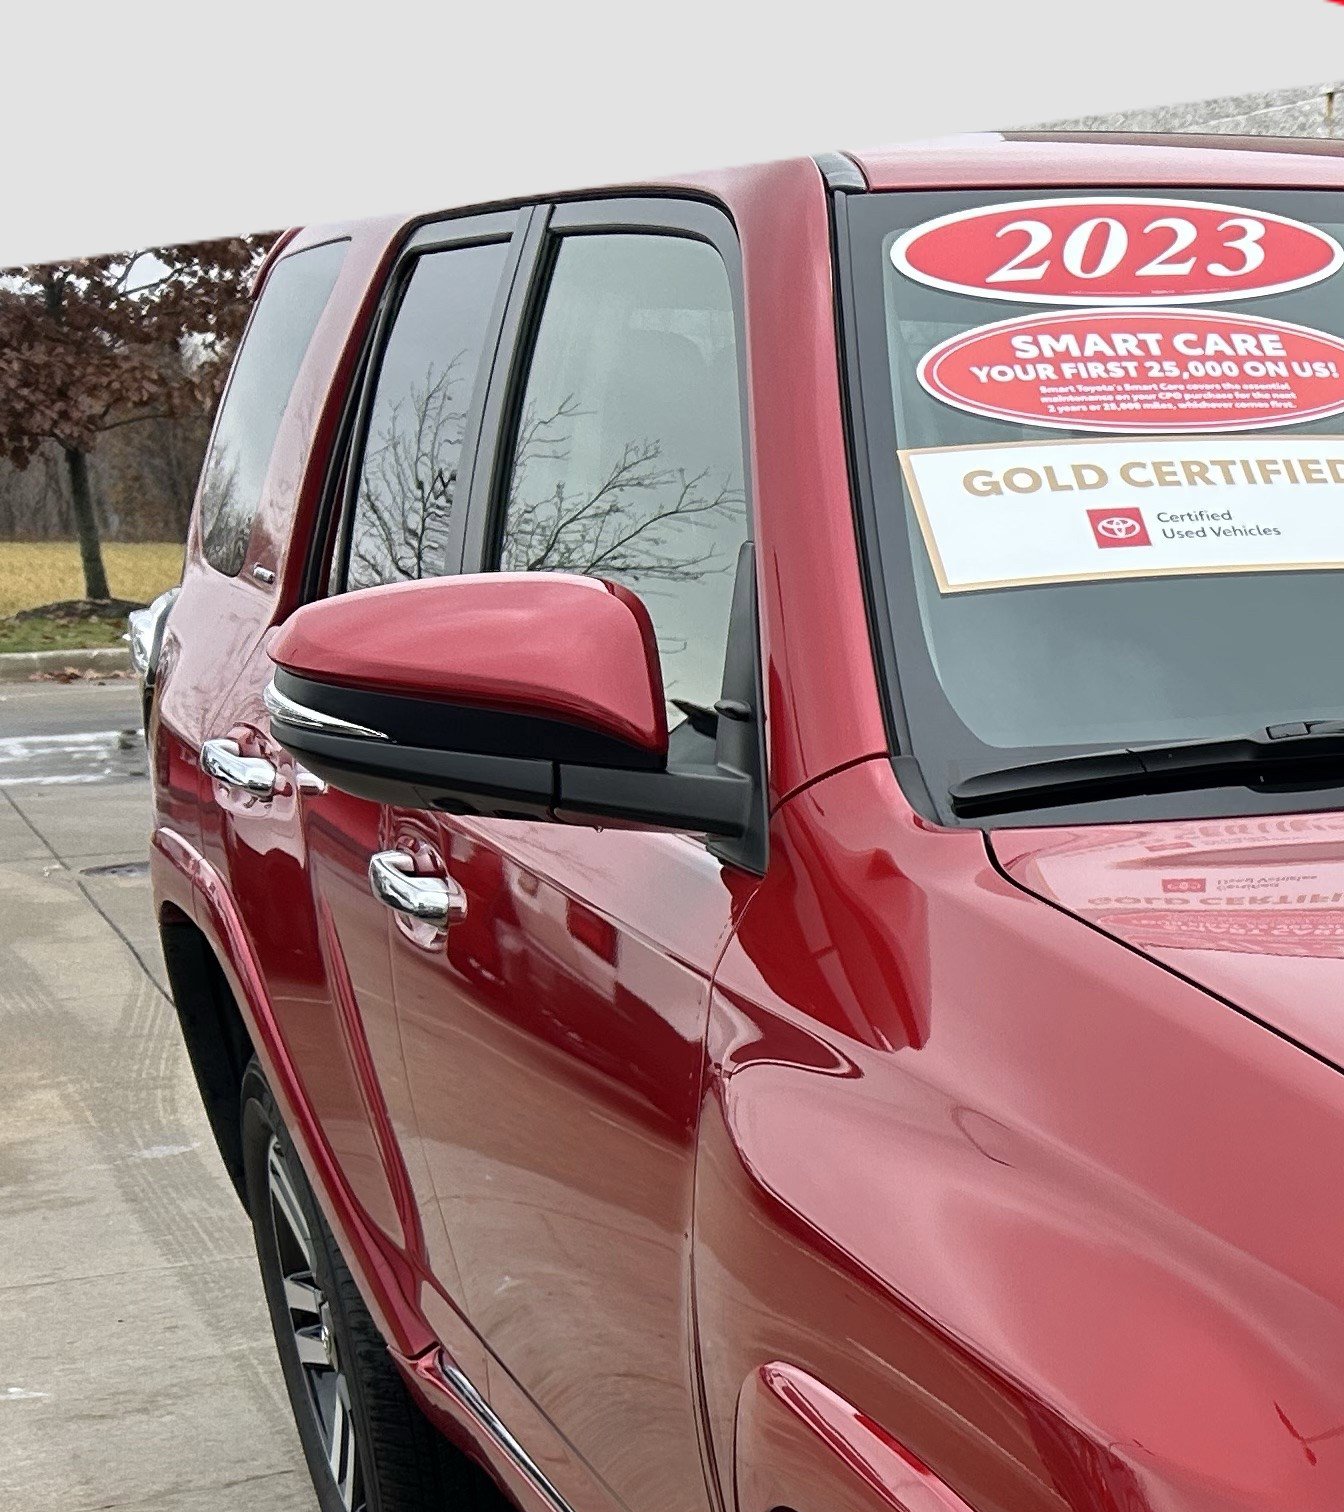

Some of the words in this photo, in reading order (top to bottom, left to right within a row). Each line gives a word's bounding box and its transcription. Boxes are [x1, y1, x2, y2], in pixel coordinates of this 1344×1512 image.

[985, 217, 1268, 284] 2023
[1011, 332, 1162, 359] SMART
[1175, 332, 1287, 358] CARE
[970, 362, 1057, 383] YOUR
[1060, 361, 1139, 380] FIRST
[1144, 360, 1238, 382] 25,000
[1242, 360, 1289, 378] ON
[1290, 361, 1340, 379] US!
[1040, 385, 1076, 394] Smart
[1123, 383, 1158, 392] Smart
[1159, 382, 1185, 391] Care
[1221, 381, 1241, 390] the
[1131, 393, 1157, 402] your
[962, 462, 1109, 498] GOLD
[1157, 509, 1233, 524] Certified
[1161, 525, 1207, 541] Used
[1209, 523, 1282, 539] Vehicles
